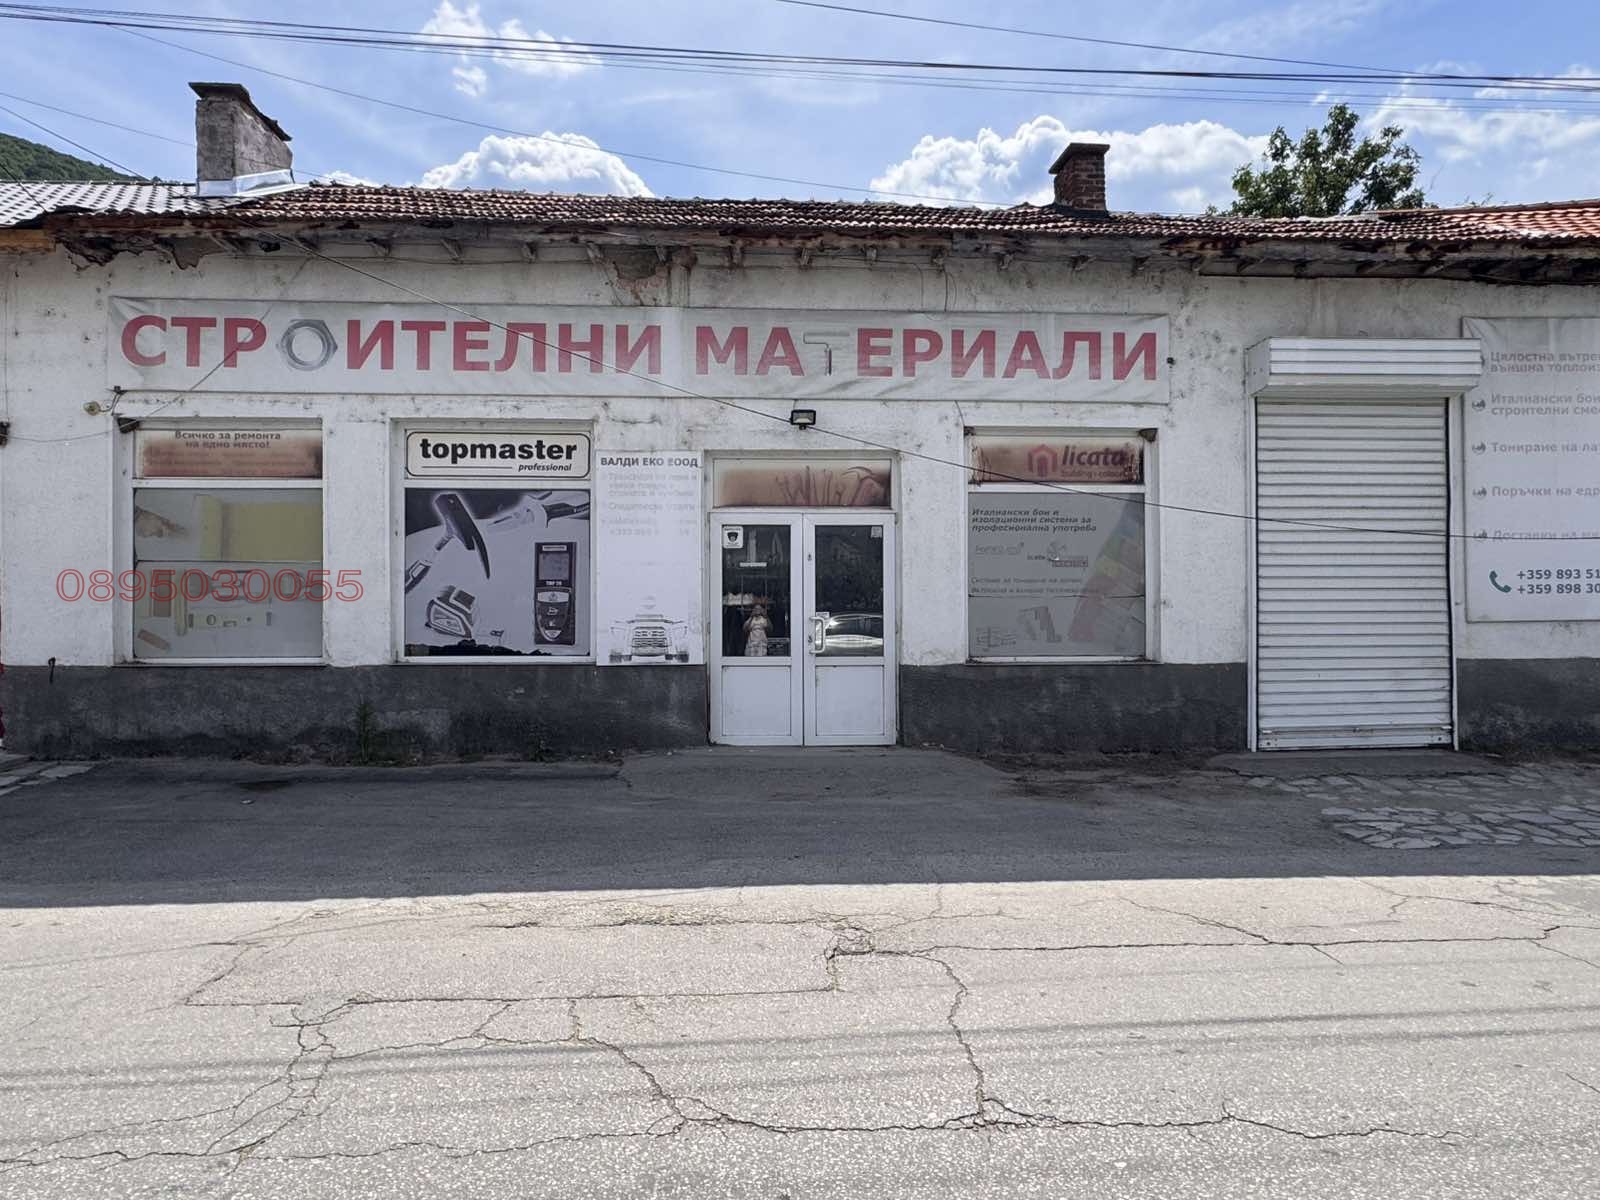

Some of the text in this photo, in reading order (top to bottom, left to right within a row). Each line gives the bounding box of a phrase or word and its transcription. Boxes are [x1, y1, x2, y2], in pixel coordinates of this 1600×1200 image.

[120, 315, 1157, 381] СТРОИТЕЛНИ МАТЕРИАЛИ
[1490, 391, 1572, 404] Италиански
[1490, 406, 1569, 417] строителни
[175, 430, 281, 441] Всичко за ремонта
[420, 438, 577, 464] topmaster
[1490, 442, 1558, 455] Тониране
[1561, 443, 1578, 452] на
[1062, 444, 1126, 466] licata
[518, 462, 572, 473] professional
[600, 457, 640, 468] ВАЛДИ
[642, 457, 664, 466] ЕКО
[1491, 486, 1552, 498] Поръчки
[1555, 487, 1573, 497] на
[1517, 569, 1552, 580] +359
[1555, 569, 1581, 579] 893
[1517, 583, 1552, 594] +359
[1555, 583, 1582, 594] 898
